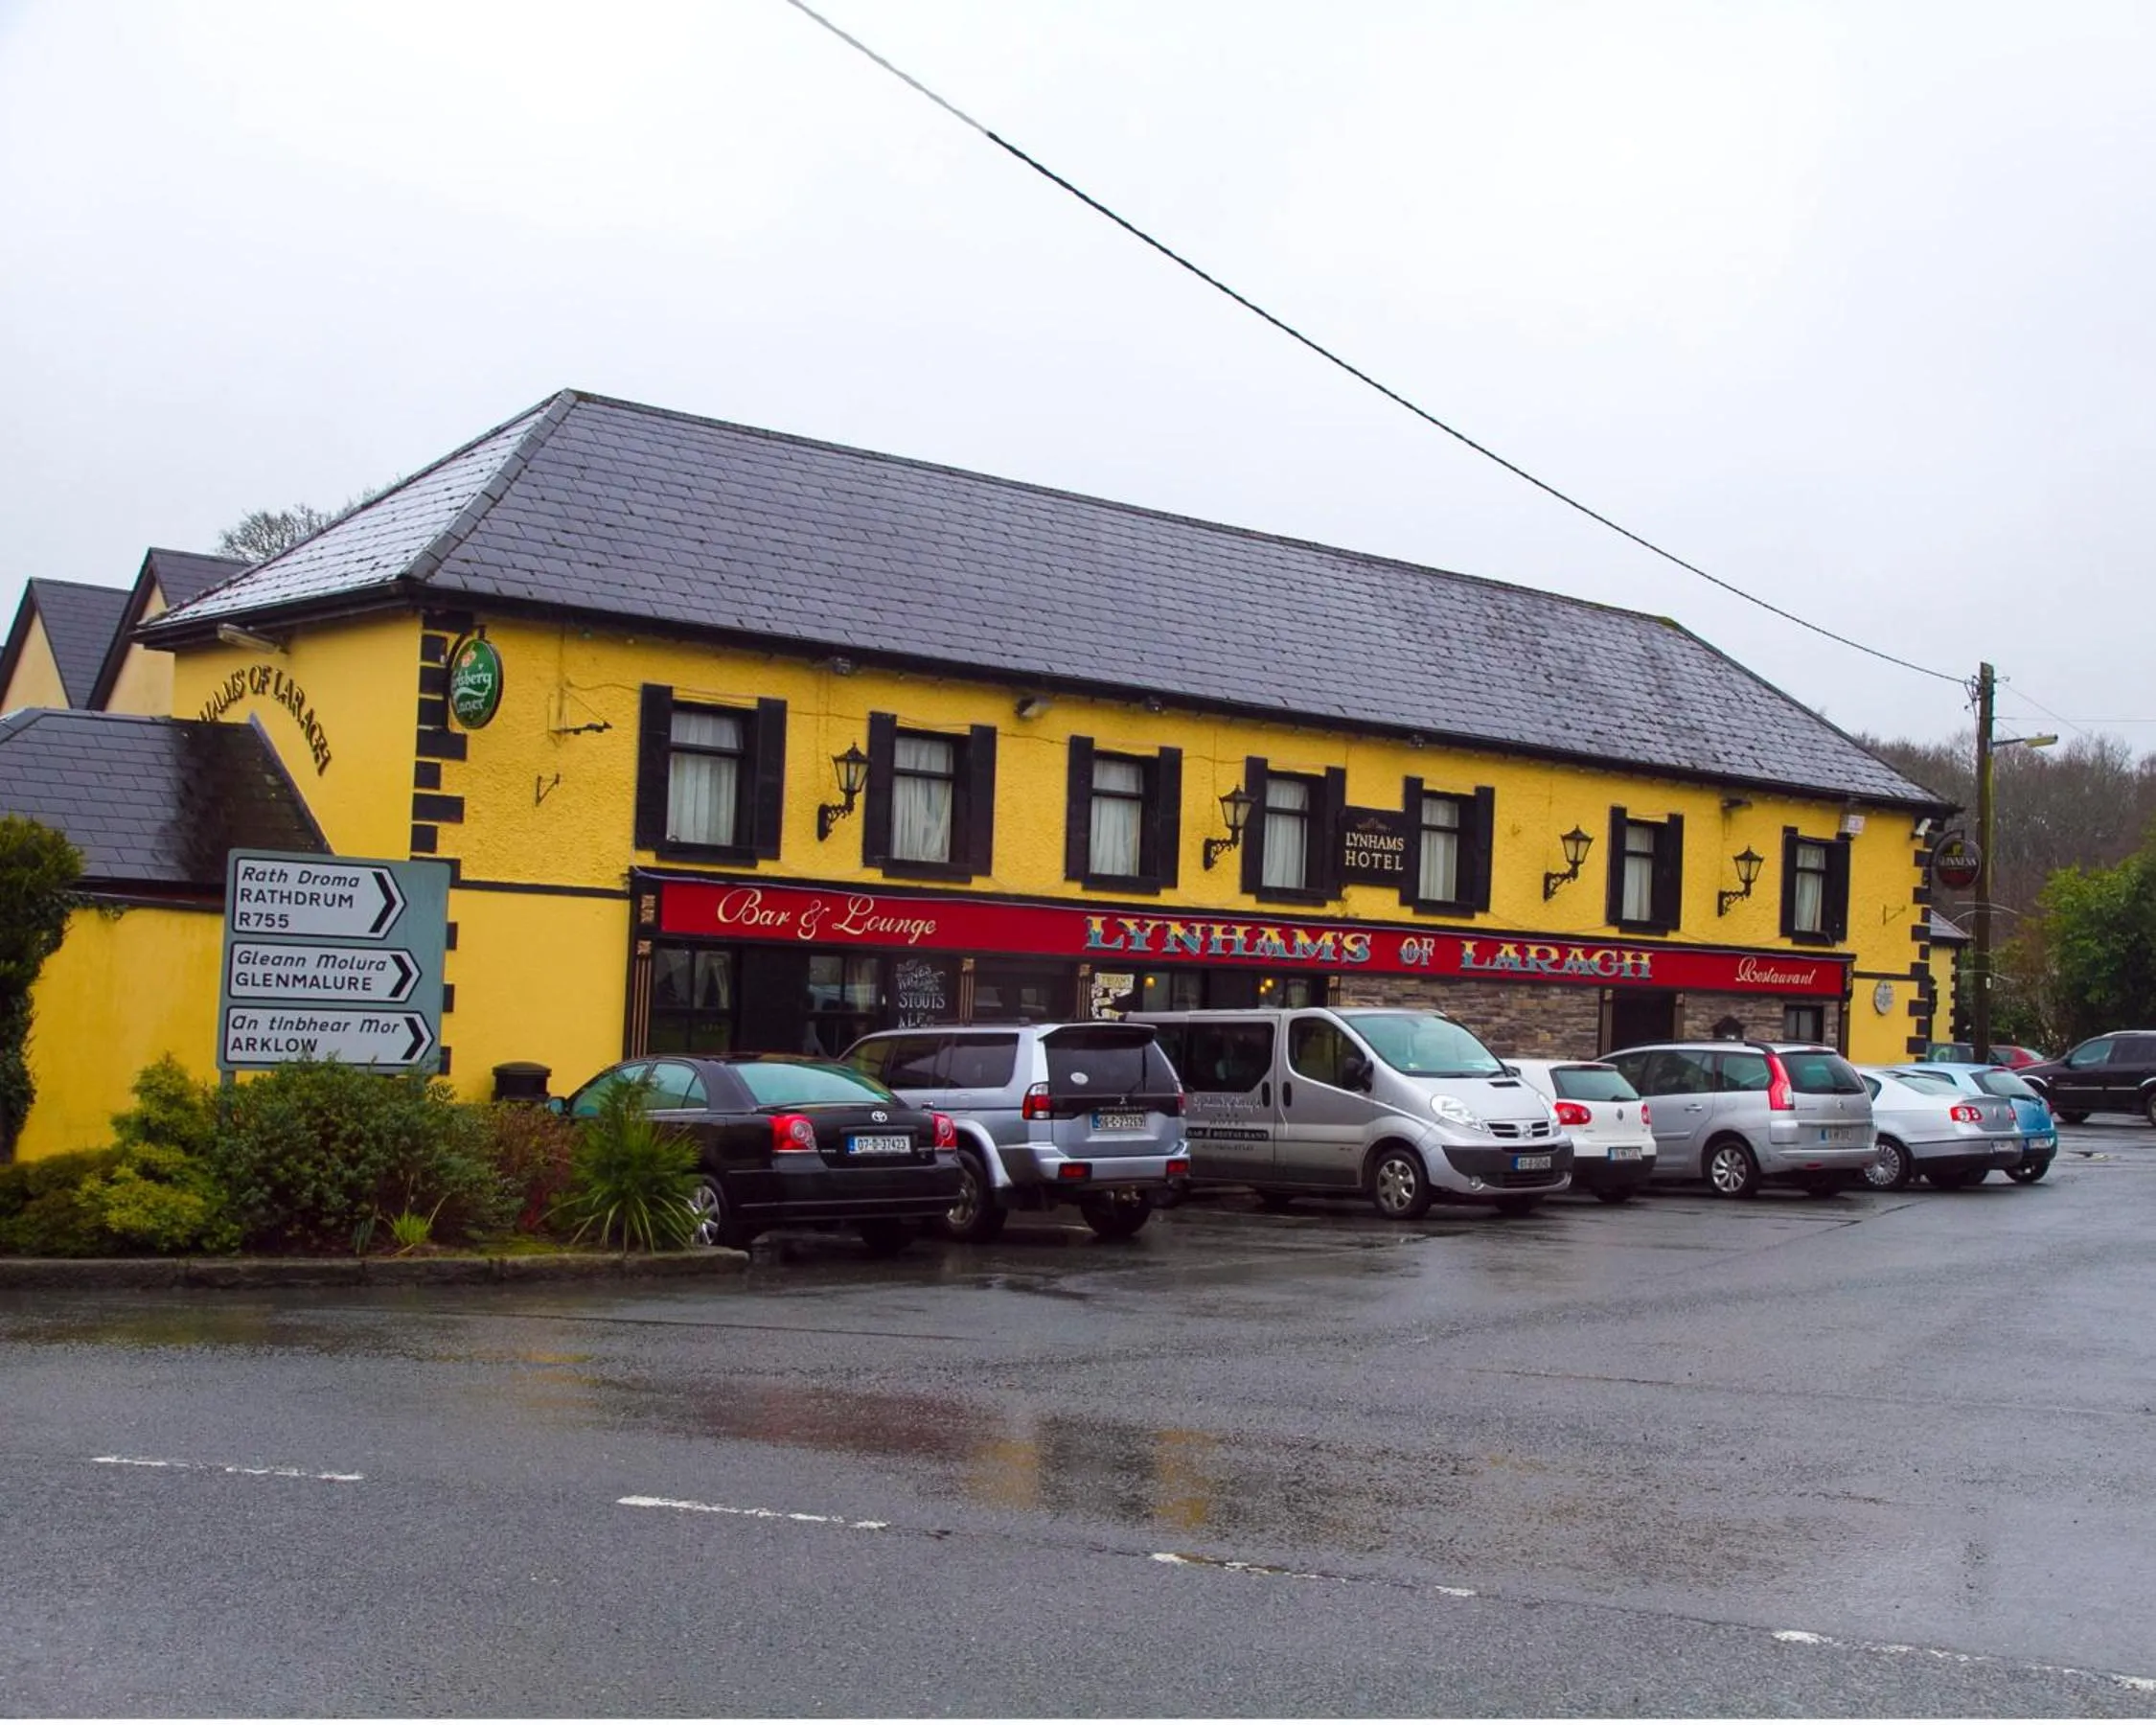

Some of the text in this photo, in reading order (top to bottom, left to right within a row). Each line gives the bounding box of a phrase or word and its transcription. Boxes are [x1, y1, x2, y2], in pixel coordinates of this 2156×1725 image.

[249, 664, 273, 696] OF
[274, 668, 333, 777] LARAGH
[1345, 832, 1405, 851] LYNHAMS
[1344, 849, 1404, 871] HOTEL
[241, 866, 360, 888] Rath Droma
[240, 888, 354, 908] RATHDRUM
[239, 912, 289, 929] R755
[717, 887, 936, 944] Bar & Lounge
[237, 951, 386, 972] Gleann Molura
[1400, 937, 1435, 967] OF
[1459, 940, 1654, 978] LARAGH
[1735, 955, 1817, 985] Restaurant
[235, 972, 373, 992] GLENMALURE
[898, 991, 946, 1009] STOUTS
[230, 1037, 318, 1053] ARKLOW
